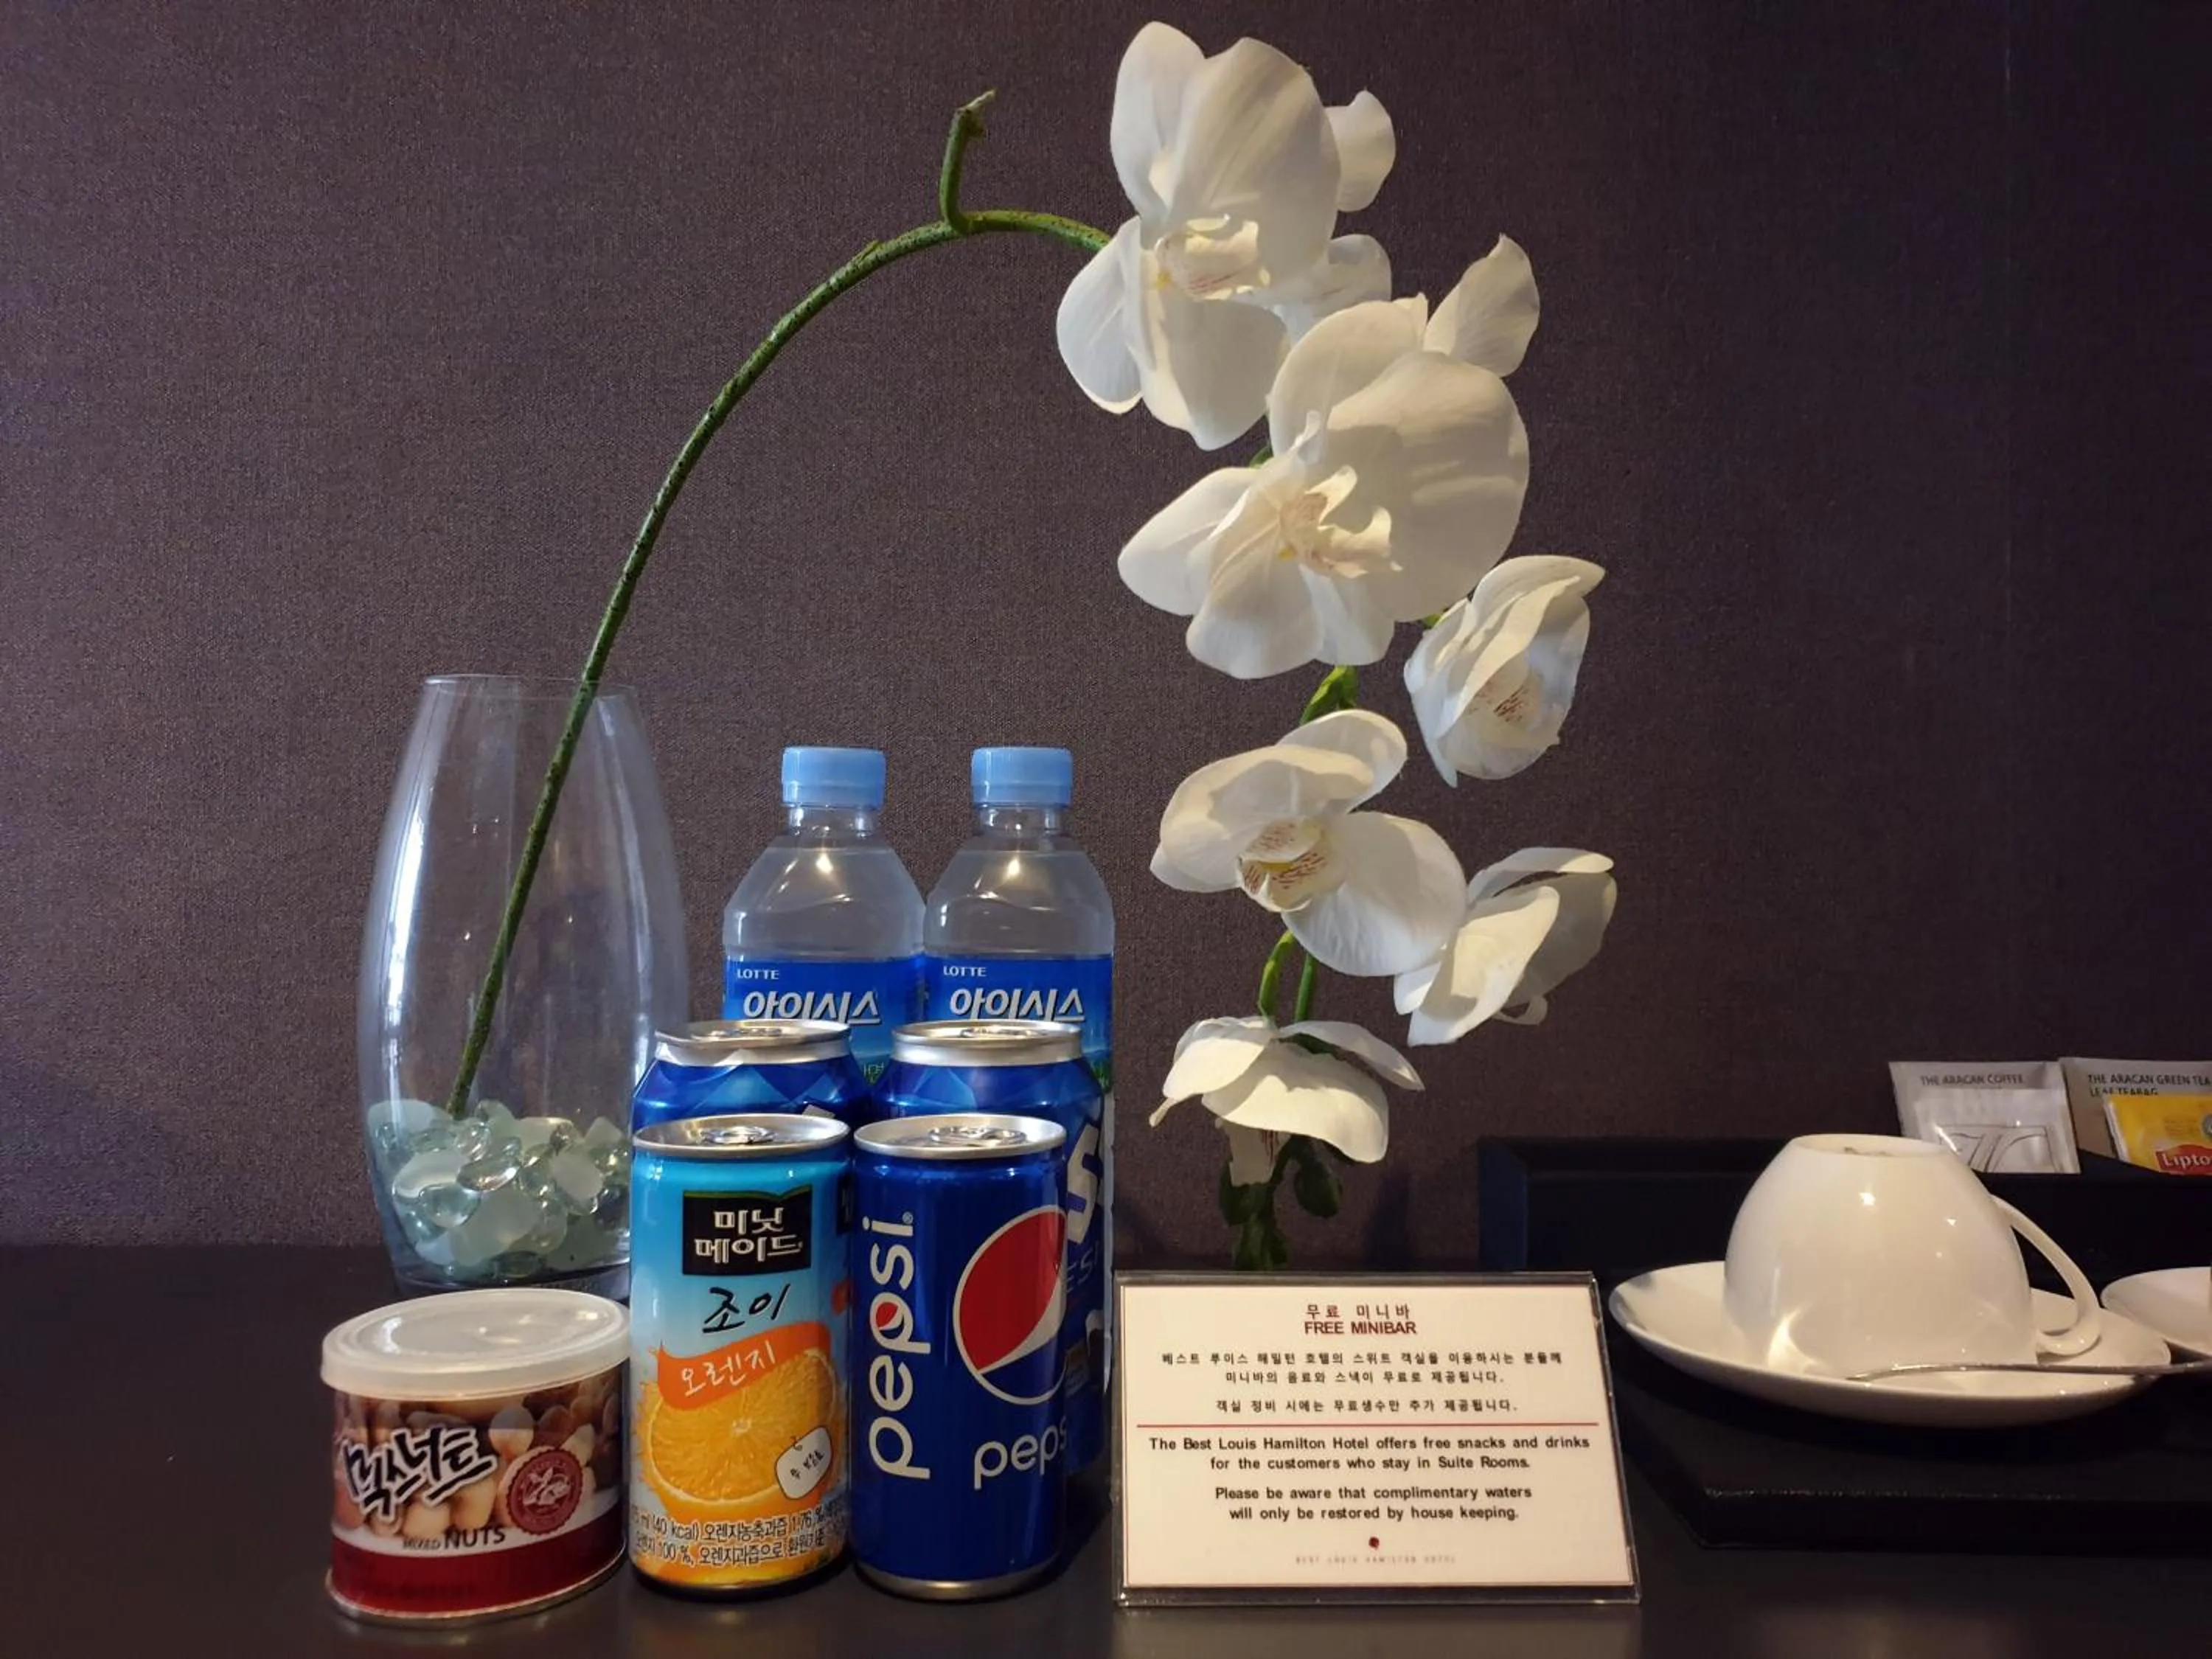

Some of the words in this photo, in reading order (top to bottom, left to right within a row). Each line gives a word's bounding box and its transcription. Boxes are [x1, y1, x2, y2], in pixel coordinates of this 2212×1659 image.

[737, 969, 779, 980] LOTTE
[943, 966, 987, 977] LOTTE
[743, 990, 880, 1024] 아이시스
[949, 989, 1085, 1021] 아이시스
[1920, 1074, 1940, 1085] THE
[2088, 1074, 2107, 1084] THE
[2110, 1074, 2154, 1085] ARACAN
[2157, 1074, 2190, 1085] GREEN
[2192, 1075, 2211, 1086] TEA
[2161, 1152, 2212, 1169] Lipto
[713, 1207, 784, 1236] 미닛
[694, 1234, 803, 1264] 메이드
[703, 1283, 791, 1334] 조이
[1306, 1304, 1340, 1320] 무료
[1356, 1304, 1410, 1320] 미니바
[1304, 1321, 1343, 1334] FREE
[1351, 1321, 1417, 1334] MINIBAR
[863, 1215, 931, 1480] pepsi
[681, 1340, 776, 1397] 오렌지
[1225, 1371, 1278, 1384] 미니바의
[1287, 1371, 1325, 1384] 음료와
[1335, 1371, 1374, 1384] 스낵이
[1383, 1371, 1422, 1384] 무료로
[1431, 1371, 1504, 1384] 제공됩니다.
[1217, 1399, 1242, 1413] 객실
[1251, 1399, 1276, 1413] 정비
[1286, 1399, 1324, 1413] 시에는
[1409, 1399, 1434, 1413] 추가
[1444, 1399, 1517, 1413] 제공됩니다.
[1150, 1437, 1176, 1450] The
[1183, 1437, 1211, 1450] Best
[1219, 1437, 1256, 1450] Louis
[1263, 1437, 1326, 1450] Hamilton
[1332, 1437, 1368, 1450] Hotel
[1376, 1436, 1417, 1450] offers
[1423, 1436, 1451, 1449] free
[1457, 1436, 1506, 1449] snacks
[1512, 1436, 1538, 1449] and
[1545, 1436, 1590, 1449] drinks
[974, 1415, 1068, 1490] peps
[1210, 1456, 1230, 1470] for
[1238, 1456, 1260, 1470] the
[1267, 1457, 1340, 1470] customers
[1347, 1456, 1375, 1470] who
[1382, 1457, 1410, 1472] stay
[1417, 1455, 1430, 1469] in
[1438, 1455, 1473, 1469] Suite
[1480, 1455, 1530, 1469] Rooms.
[1215, 1486, 1259, 1500] Please
[1266, 1486, 1283, 1500] be
[1290, 1489, 1332, 1500] aware
[1338, 1486, 1366, 1500] that
[1373, 1486, 1478, 1501] complimentary
[1484, 1487, 1532, 1499] waters
[1229, 1506, 1253, 1520] will
[1259, 1506, 1290, 1523] only
[1297, 1506, 1314, 1520] be
[1321, 1506, 1380, 1520] restored
[1387, 1506, 1404, 1522] by
[1411, 1506, 1454, 1519] house
[1460, 1506, 1519, 1521] keeping.
[442, 1523, 506, 1549] NUTS
[671, 1520, 699, 1542] kcal)
[703, 1518, 786, 1543] 오렌지농축과즙
[700, 1541, 782, 1566] 오렌지과즙으로
